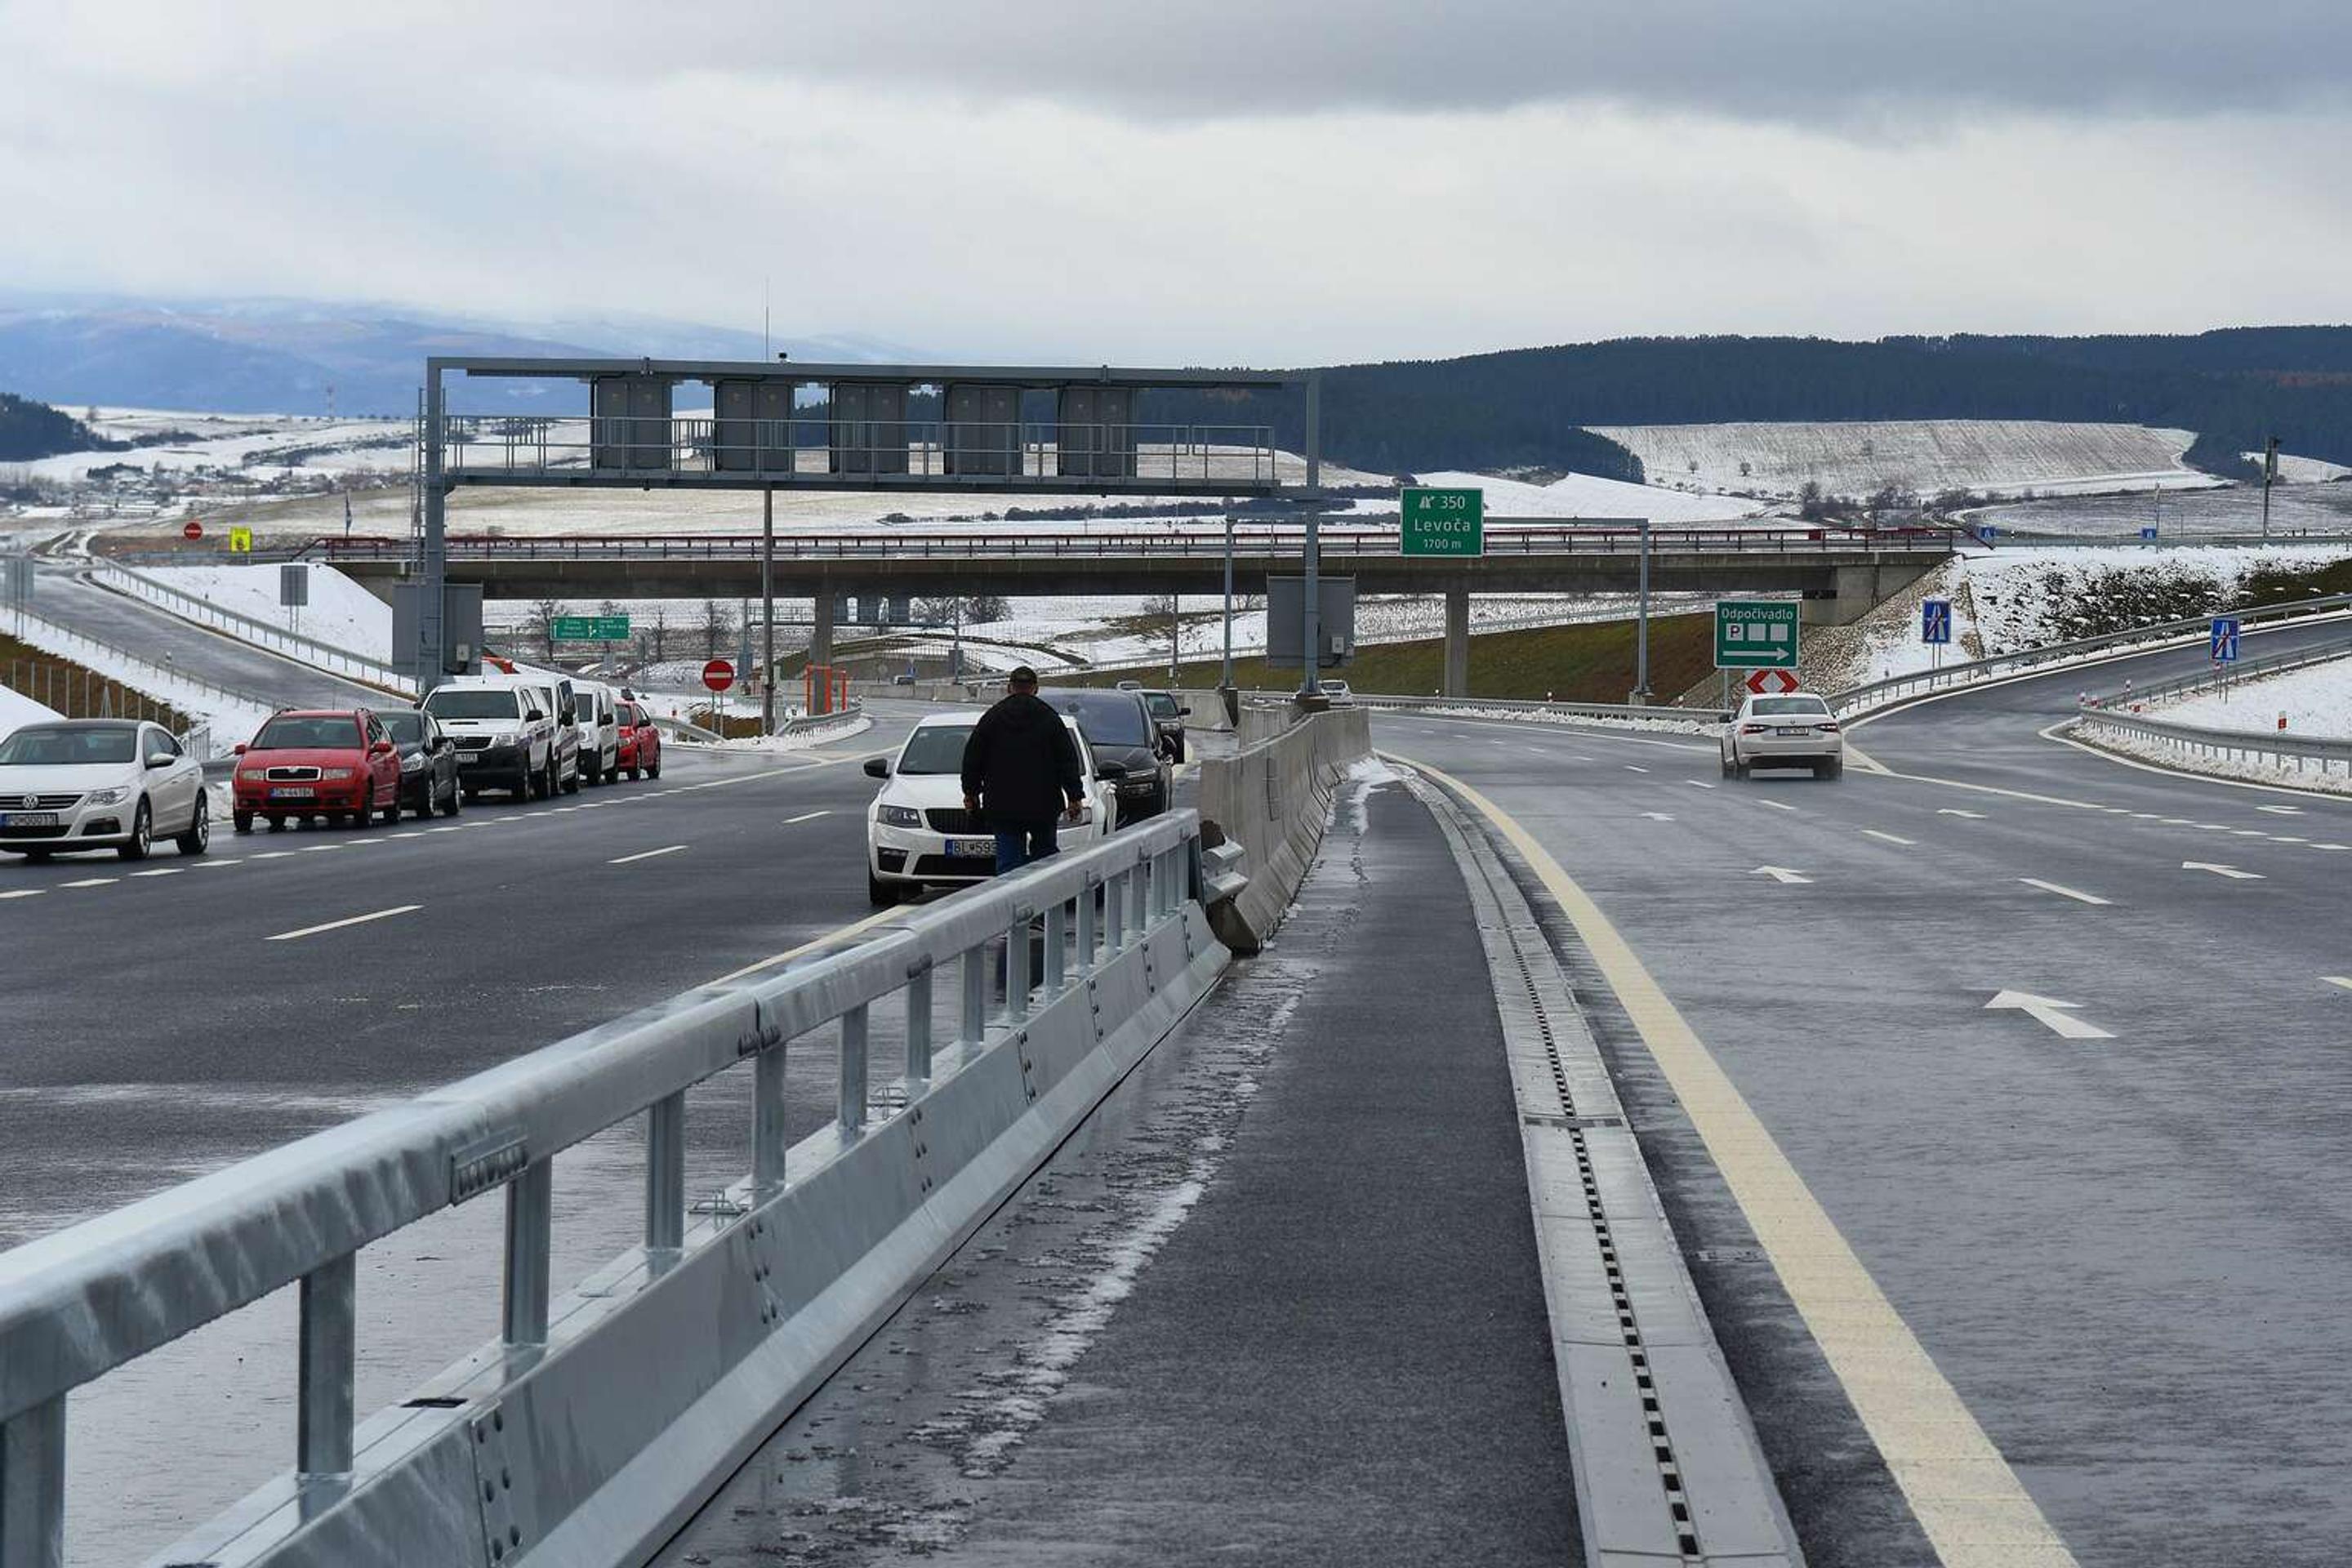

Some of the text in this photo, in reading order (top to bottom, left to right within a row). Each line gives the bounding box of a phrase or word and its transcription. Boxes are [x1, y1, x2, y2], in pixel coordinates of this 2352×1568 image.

[1440, 496, 1465, 509] 350
[1414, 518, 1471, 532] Levoča
[1423, 539, 1462, 550] 1700 m
[1730, 625, 1740, 638] P
